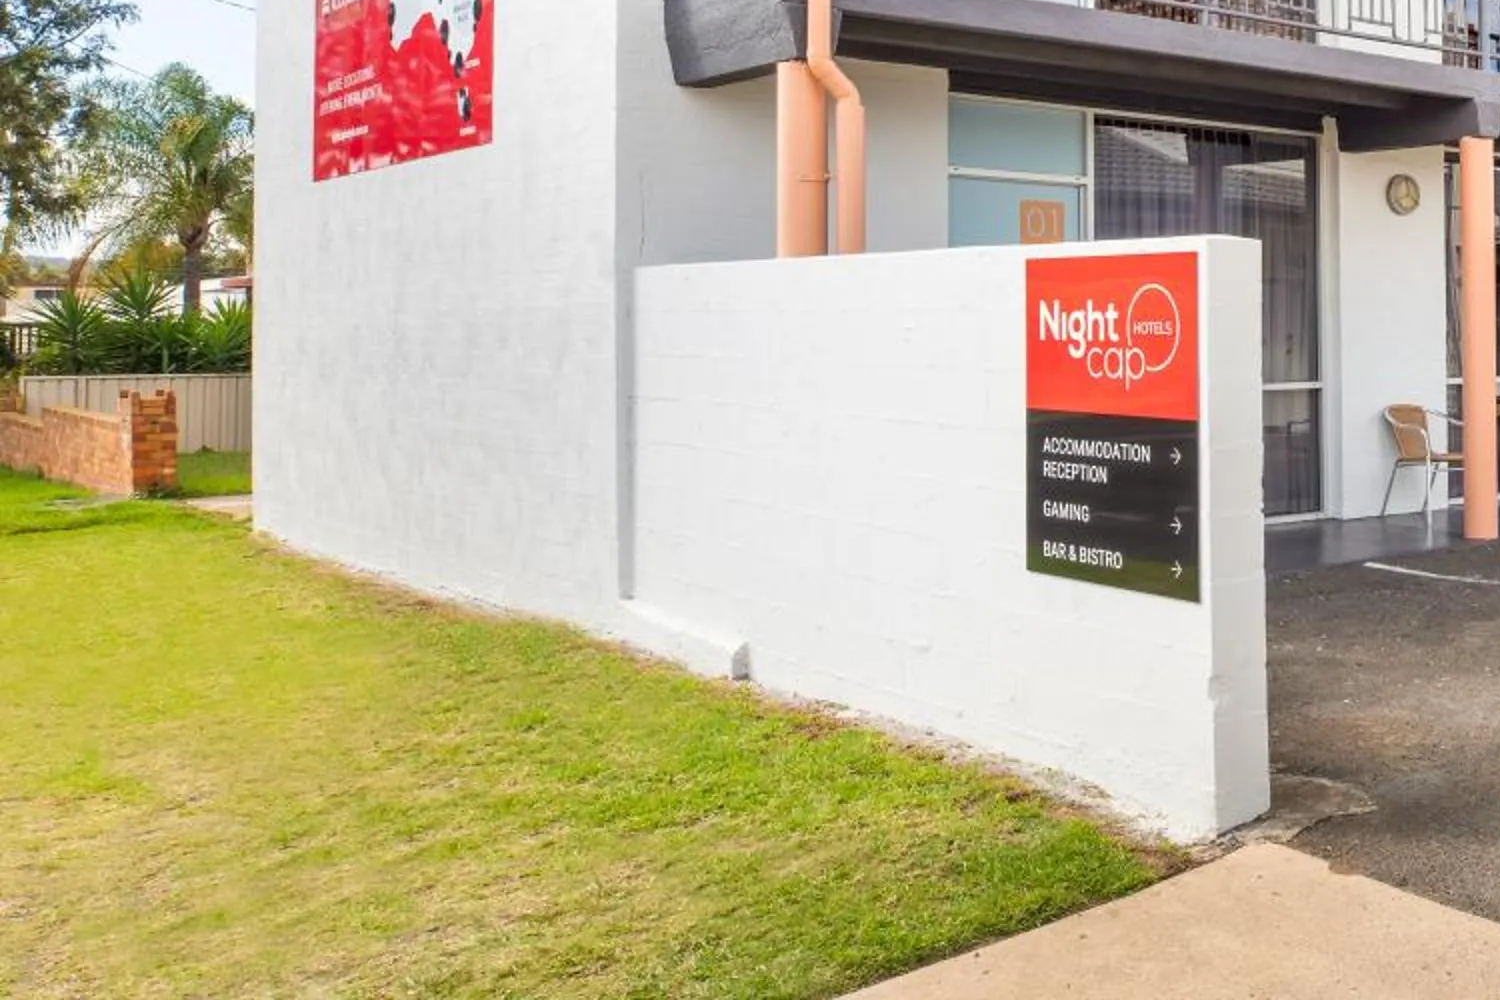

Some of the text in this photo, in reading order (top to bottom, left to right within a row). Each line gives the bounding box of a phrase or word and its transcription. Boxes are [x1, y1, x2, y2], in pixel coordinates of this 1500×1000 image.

[1026, 205, 1058, 238] 01
[1039, 298, 1120, 359] Night
[1133, 320, 1173, 337] HOTELS
[1086, 346, 1146, 392] cap
[1042, 436, 1152, 464] ACCOMMODATION
[1042, 460, 1108, 484] RECEPTION
[1042, 499, 1091, 523] GAMING
[1043, 540, 1124, 570] BAR & BISTRO
